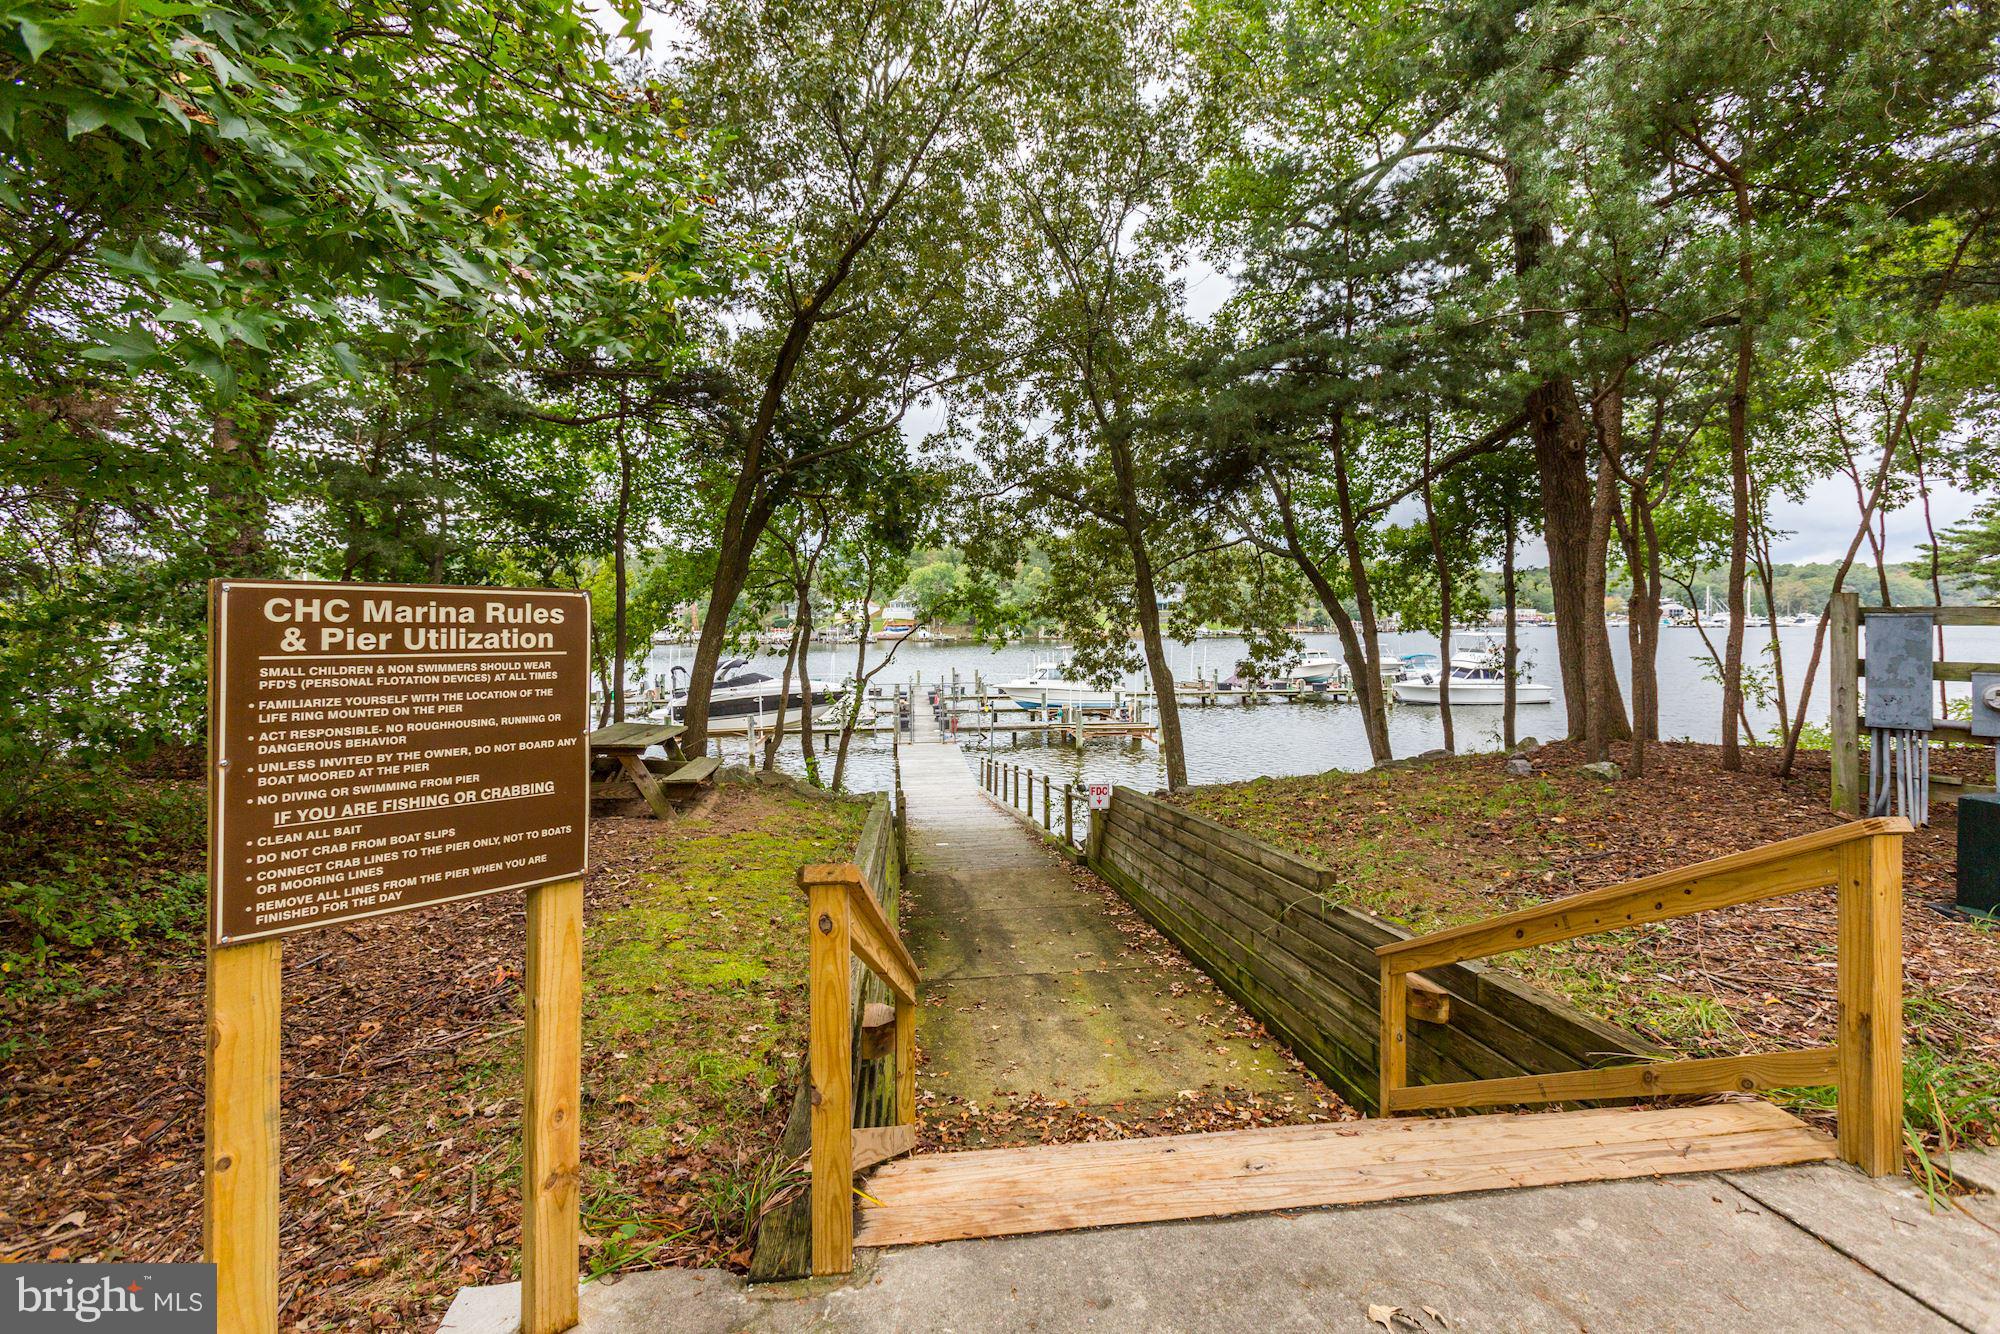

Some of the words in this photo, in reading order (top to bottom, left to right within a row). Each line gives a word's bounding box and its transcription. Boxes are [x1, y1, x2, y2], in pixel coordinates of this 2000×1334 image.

[263, 597, 350, 623] CHC
[363, 599, 475, 624] Marina
[486, 602, 565, 624] Rules
[280, 627, 307, 652] &
[320, 627, 392, 651] Pier
[404, 627, 554, 651] Utilization
[259, 667, 306, 678] SMALL
[309, 665, 373, 676] CHILDREN
[376, 665, 385, 674] &
[388, 664, 414, 674] NON
[416, 662, 478, 673] SWIMMERS
[480, 662, 521, 672] SHOULD
[523, 661, 551, 670] WEAR
[259, 679, 297, 690] PFD'S
[300, 677, 374, 690] (PERSONAL
[376, 675, 440, 686] FLOTATION
[442, 673, 491, 684] DEVICES)
[494, 673, 507, 682] AT
[508, 672, 527, 681] ALL
[528, 671, 558, 680] TIMES
[259, 697, 342, 710] FAMILIARIZE
[344, 694, 409, 706] YOURSELF
[410, 693, 440, 703] WITH
[442, 692, 464, 702] THE
[466, 690, 517, 701] LOCATION
[519, 689, 533, 698] OF
[534, 688, 553, 697] THE
[258, 712, 288, 724] LIFE
[291, 710, 324, 722] RING
[327, 707, 389, 720] MOUNTED
[392, 706, 410, 716] ON
[412, 705, 435, 715] THE
[437, 704, 463, 714] PIER
[259, 730, 287, 742] ACT
[385, 723, 404, 733] NO
[406, 717, 499, 732] ROUGHHOUSING,
[501, 714, 546, 726] RUNNING
[547, 713, 562, 722] OR
[258, 739, 342, 755] DANGEROUS
[345, 735, 407, 748] BEHAVIOR
[258, 759, 316, 773] UNLESS
[320, 755, 373, 768] INVITED
[376, 753, 393, 763] BY
[396, 750, 421, 761] THE
[424, 747, 472, 759] OWNER,
[474, 745, 491, 755] DO
[493, 742, 517, 753] NOT
[519, 739, 555, 751] BOARD
[557, 737, 577, 747] ANY
[257, 774, 295, 787] BOAT
[298, 769, 355, 783] MOORED
[358, 767, 374, 777] AT
[376, 765, 400, 776] THE
[403, 762, 430, 773] PIER
[257, 794, 278, 805] NO
[282, 789, 327, 803] DIVING
[330, 787, 349, 798] OR
[352, 780, 417, 795] SWIMMING
[420, 776, 453, 788] FROM
[455, 774, 480, 785] PIER
[274, 810, 292, 825] IF
[296, 805, 336, 822] YOU
[341, 801, 378, 817] ARE
[382, 793, 450, 812] FISHING
[453, 790, 476, 804] OR
[480, 781, 555, 801] CRABBING
[1090, 786, 1108, 796] FDC
[256, 852, 277, 865] DO
[280, 848, 309, 861] NOT
[311, 842, 348, 856] CRAB
[351, 837, 387, 851] FROM
[390, 832, 422, 845] BOAT
[424, 828, 456, 841] SLIPS
[257, 832, 302, 847] CLEAN
[305, 829, 331, 841] ALL
[333, 824, 363, 837] BAIT
[256, 862, 323, 881] CONNECT
[325, 857, 361, 871] CRAB
[364, 851, 399, 865] LINES
[401, 848, 418, 859] TO
[420, 844, 443, 856] THE
[445, 841, 470, 853] PIER
[472, 836, 501, 848] ONLY,
[503, 832, 524, 844] NOT
[525, 830, 539, 840] TO
[541, 825, 572, 837] BOATS
[256, 883, 277, 895] OR
[280, 872, 345, 891] MOORING
[348, 866, 384, 880] LINES
[256, 894, 314, 913] REMOVE
[316, 890, 341, 902] ALL
[344, 882, 380, 897] LINES
[383, 876, 417, 891] FROM
[419, 872, 442, 884] THE
[444, 868, 470, 880] PIER
[472, 862, 503, 875] WHEN
[505, 858, 526, 869] YOU
[527, 854, 547, 865] ARE
[256, 905, 319, 925] FINISHED
[322, 900, 349, 913] FOR
[351, 895, 376, 908] THE
[379, 890, 403, 903] DAY
